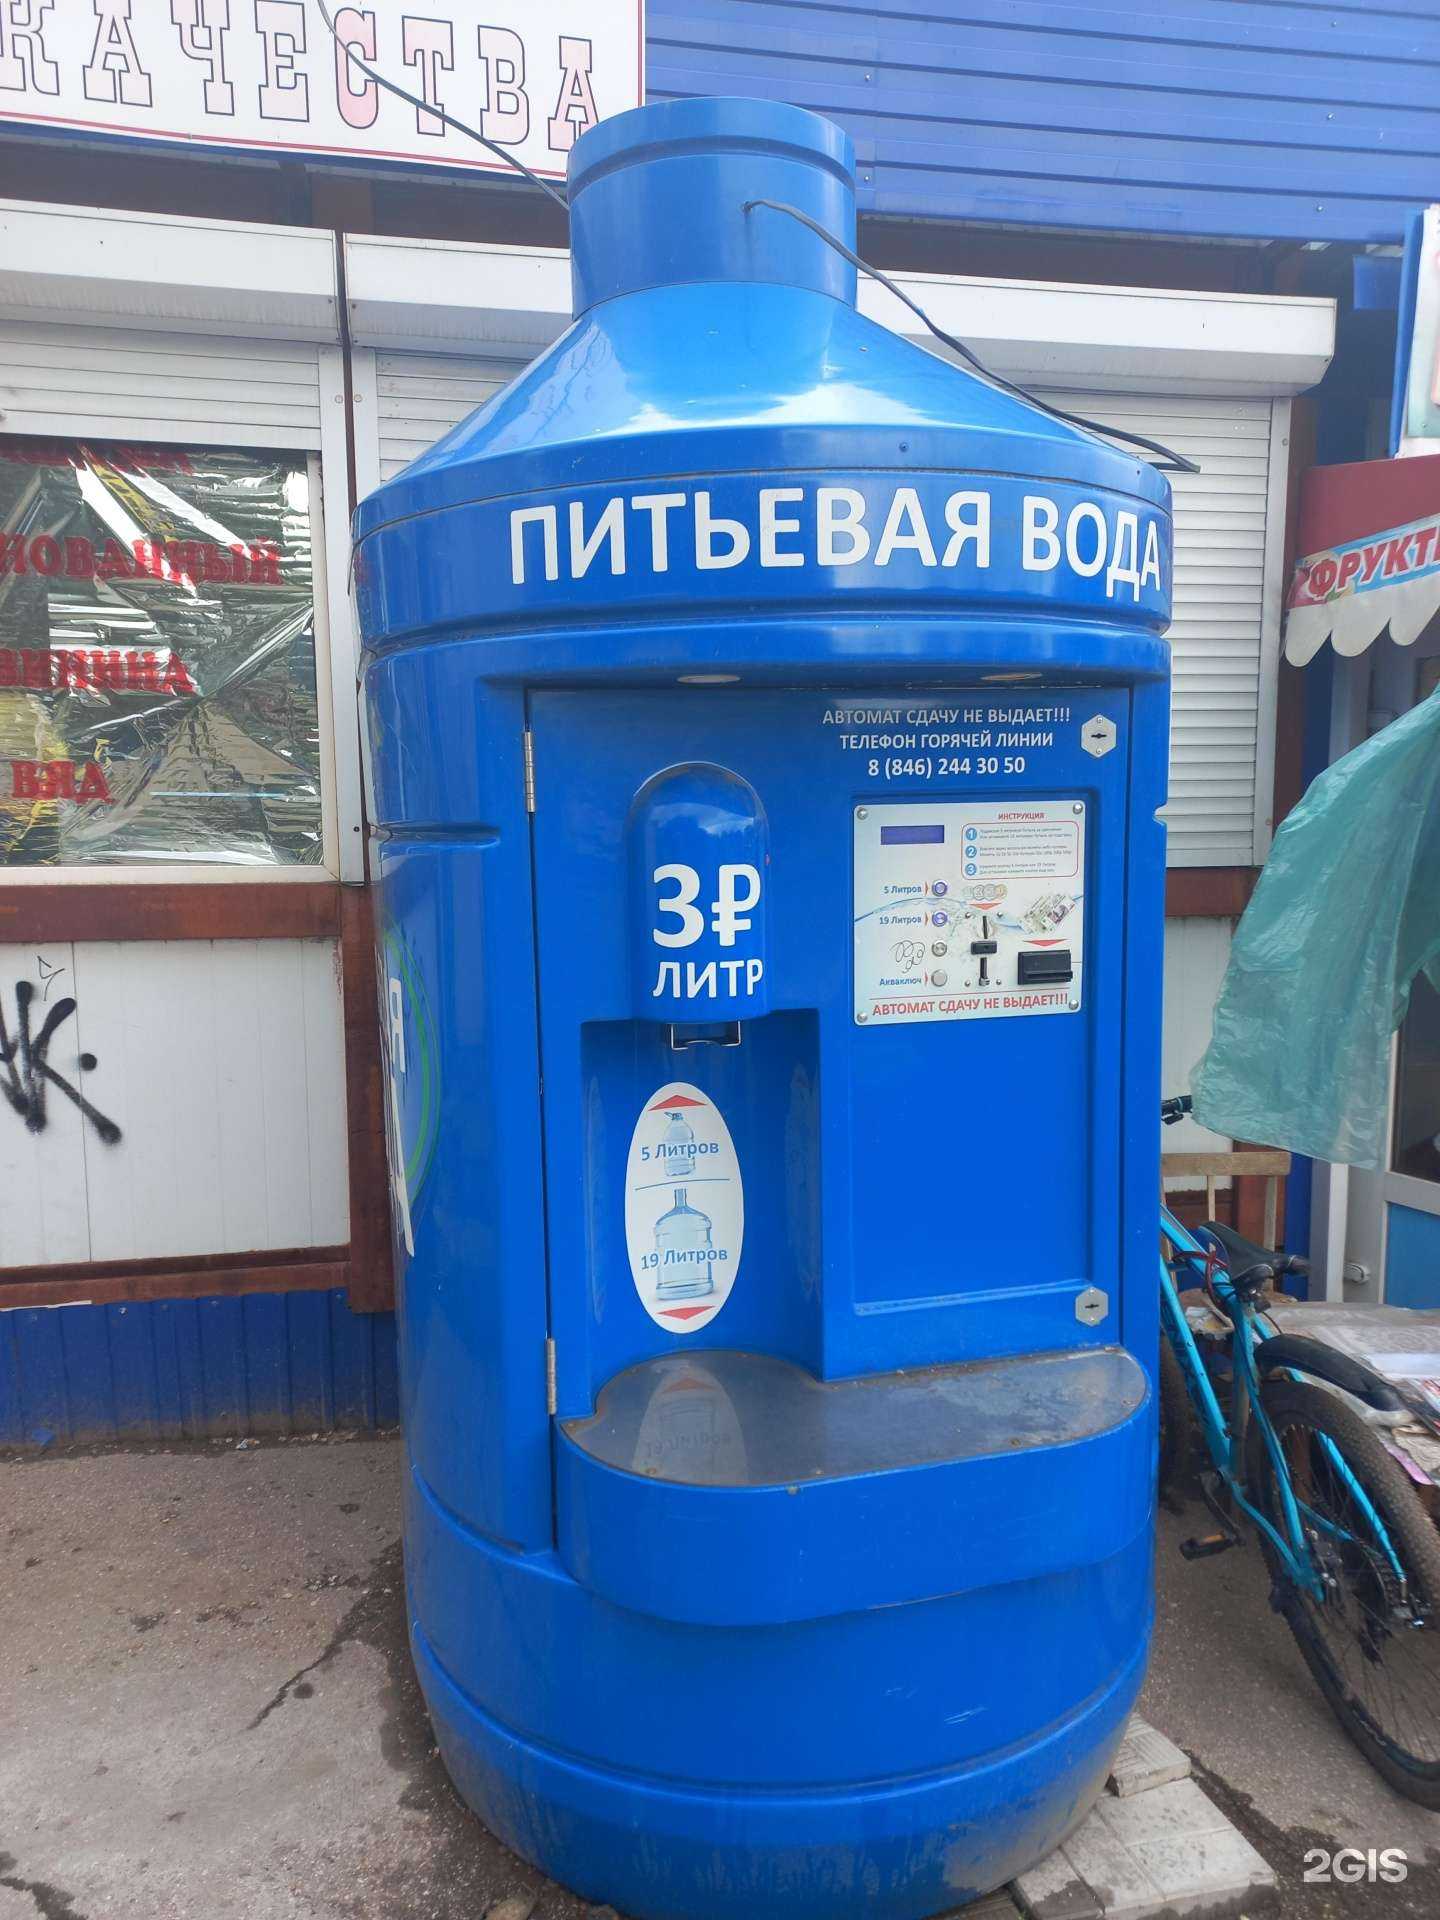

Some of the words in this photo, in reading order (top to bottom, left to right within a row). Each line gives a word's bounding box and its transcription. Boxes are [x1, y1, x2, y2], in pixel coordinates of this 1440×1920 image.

[0, 0, 600, 152] КАЧЕСТВА
[510, 487, 991, 585] ПИТЬЕВАЯ
[1022, 495, 1161, 602] ВОДА
[822, 709, 902, 725] АВТОМАТ
[906, 708, 960, 726] СДАЧУ
[963, 708, 983, 723] НЕ
[988, 707, 1071, 725] ВЫДАЕТ!!!
[839, 734, 917, 750] ТЕЛЕФОН
[921, 730, 991, 748] ГОРЯЧЕЙ
[995, 732, 1053, 747] ЛИНИИ
[868, 759, 879, 776] 8
[884, 757, 933, 780] (846)
[937, 758, 971, 775] 244
[976, 757, 999, 774] 30
[1003, 757, 1026, 774] 50
[998, 812, 1045, 821] ИНСТРУКЦИЯ
[890, 885, 922, 895] Литров
[879, 916, 889, 925] 19
[890, 915, 922, 926] Литров
[652, 958, 764, 999] ЛИТР
[879, 977, 922, 987] Акваключ
[872, 1000, 936, 1016] АВТОМАТ
[939, 998, 980, 1014] СДАЧУ
[983, 997, 1000, 1010] НЕ
[1003, 993, 1068, 1010] ВЫДАЕТ!!!
[641, 1146, 650, 1161] 5
[655, 1141, 719, 1158] Литров
[641, 1252, 659, 1270] 19
[663, 1248, 728, 1265] Литров
